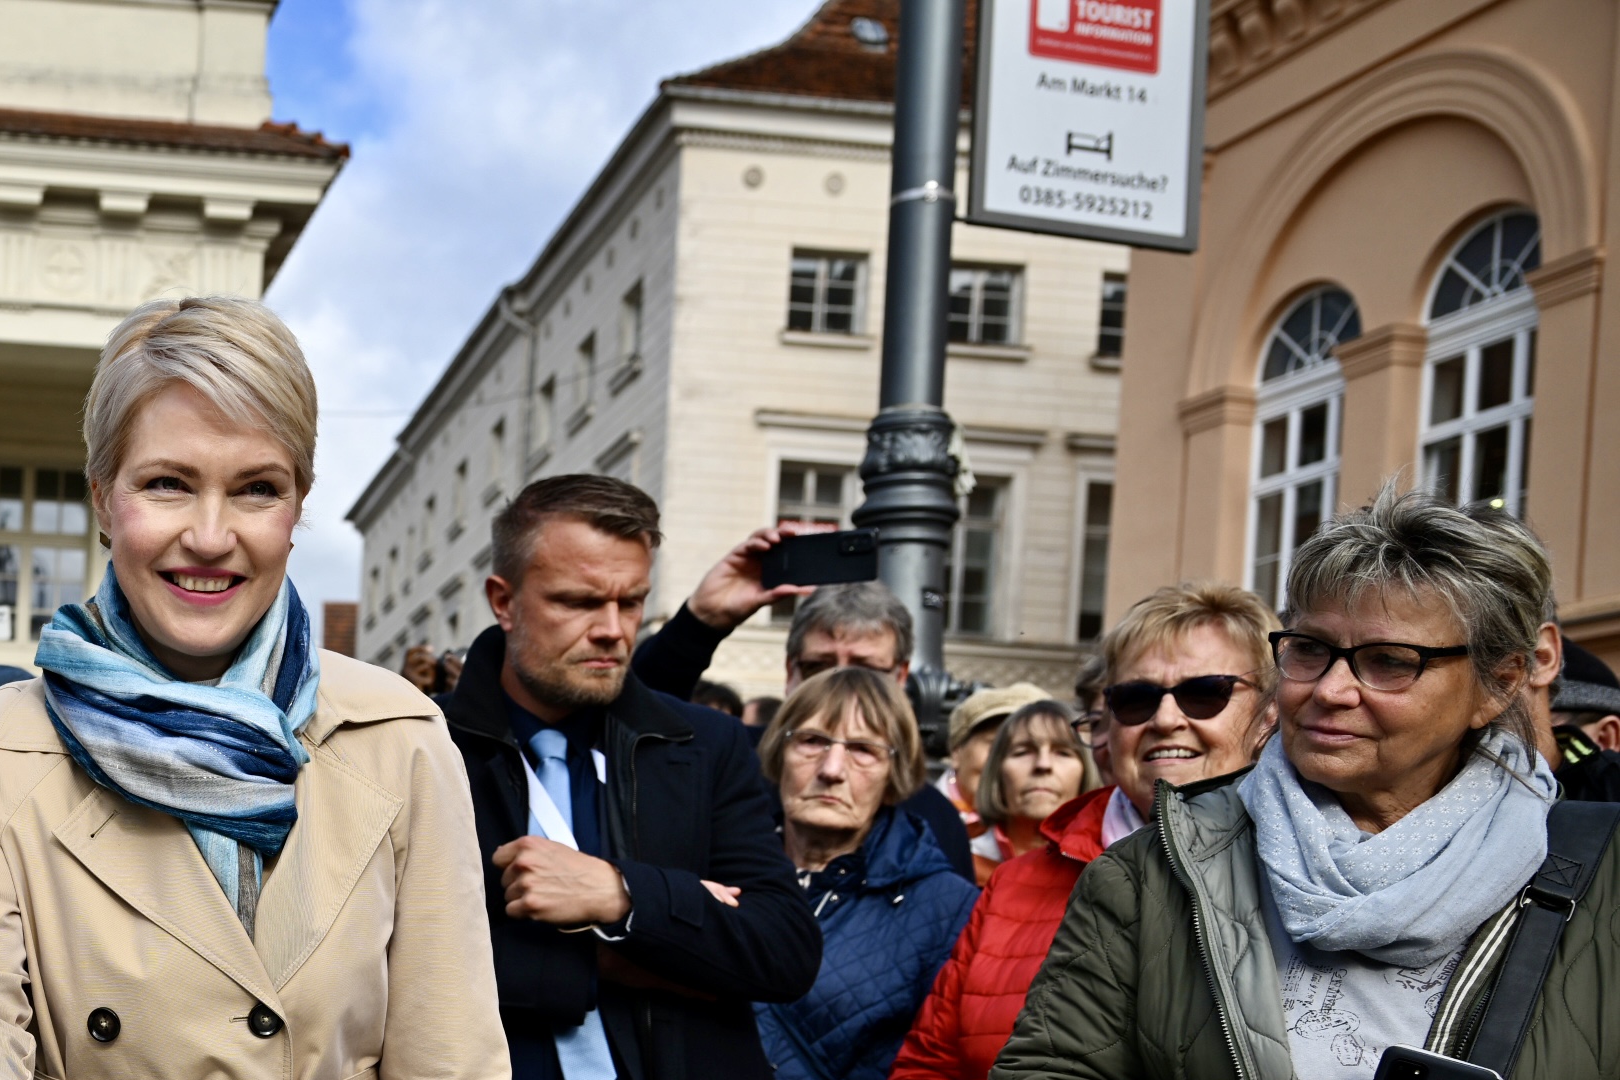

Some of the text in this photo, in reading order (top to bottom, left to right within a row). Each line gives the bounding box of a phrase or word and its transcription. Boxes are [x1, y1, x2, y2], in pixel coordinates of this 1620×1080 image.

[1074, 0, 1154, 30] TOURIST
[1036, 72, 1148, 105] Am Markt 14
[1007, 153, 1169, 194] Auf Zimmersuche?
[1018, 183, 1154, 221] 0385-5925212
